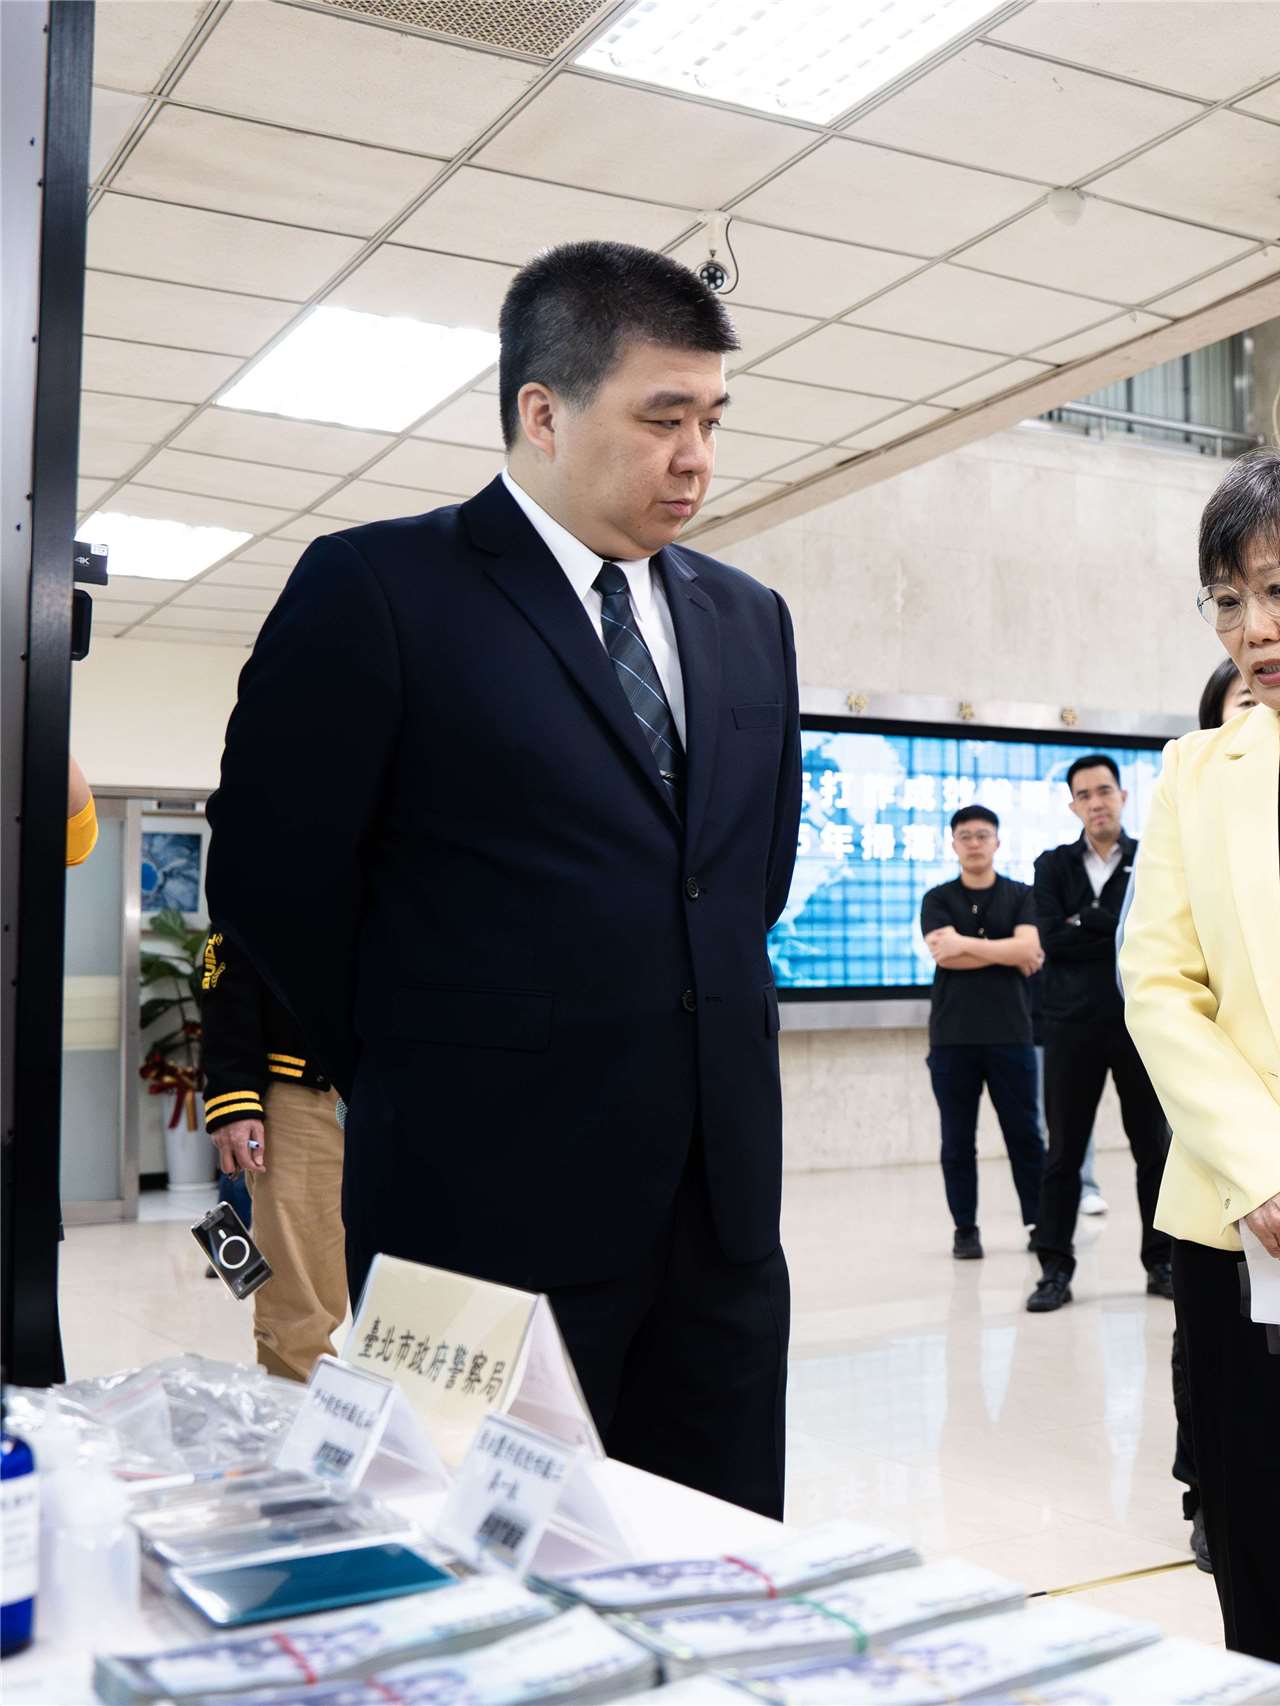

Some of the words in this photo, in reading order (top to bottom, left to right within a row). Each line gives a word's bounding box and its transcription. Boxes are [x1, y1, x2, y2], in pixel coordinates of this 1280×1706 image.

[357, 1315, 506, 1403] 臺北市政府警察局
